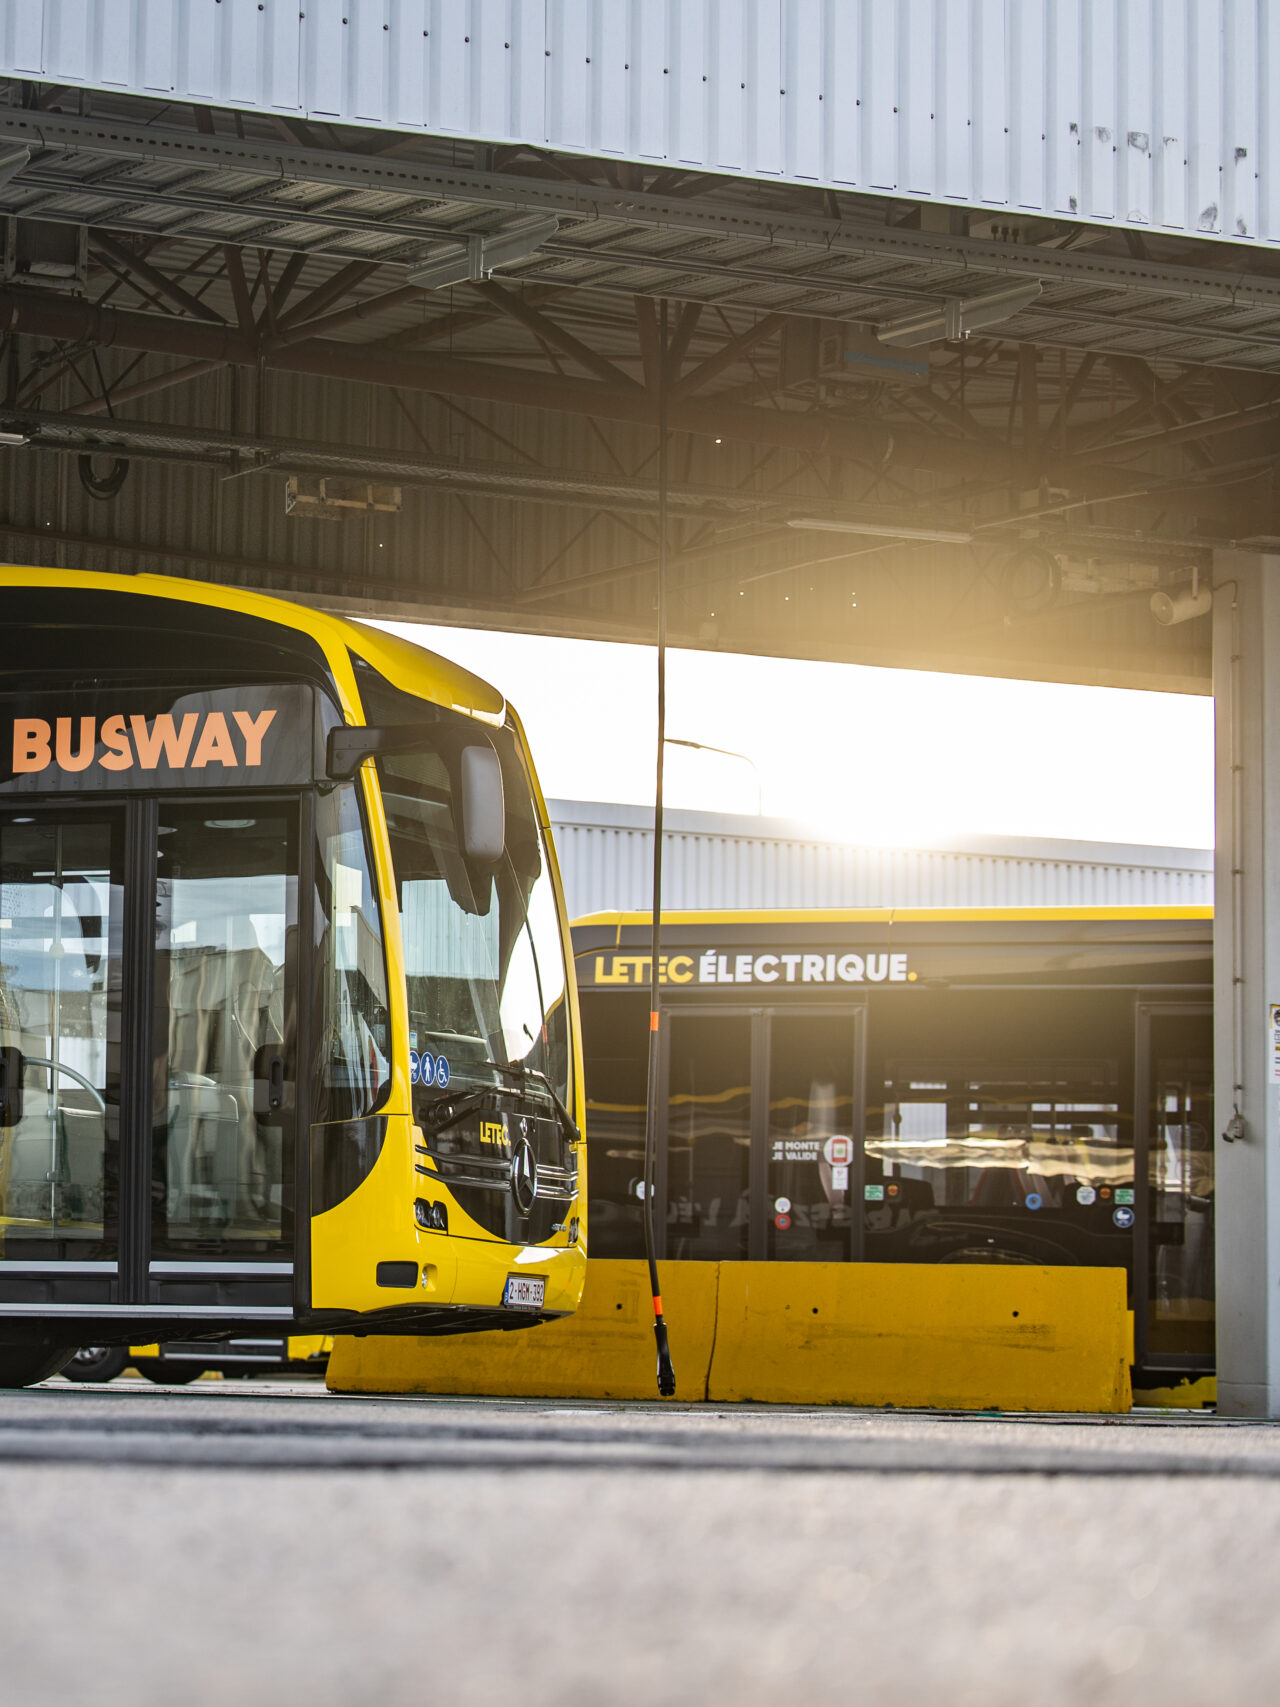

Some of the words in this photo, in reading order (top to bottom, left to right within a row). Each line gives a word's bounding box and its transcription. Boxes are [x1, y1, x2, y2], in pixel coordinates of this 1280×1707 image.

[12, 710, 277, 773] BUSWAY
[594, 955, 695, 984] LETEC
[698, 949, 918, 983] ÉLECTRIQUE.
[772, 1141, 784, 1150] JE
[785, 1141, 820, 1150] MONTE
[772, 1152, 784, 1160] JE
[785, 1152, 818, 1160] VALIDE
